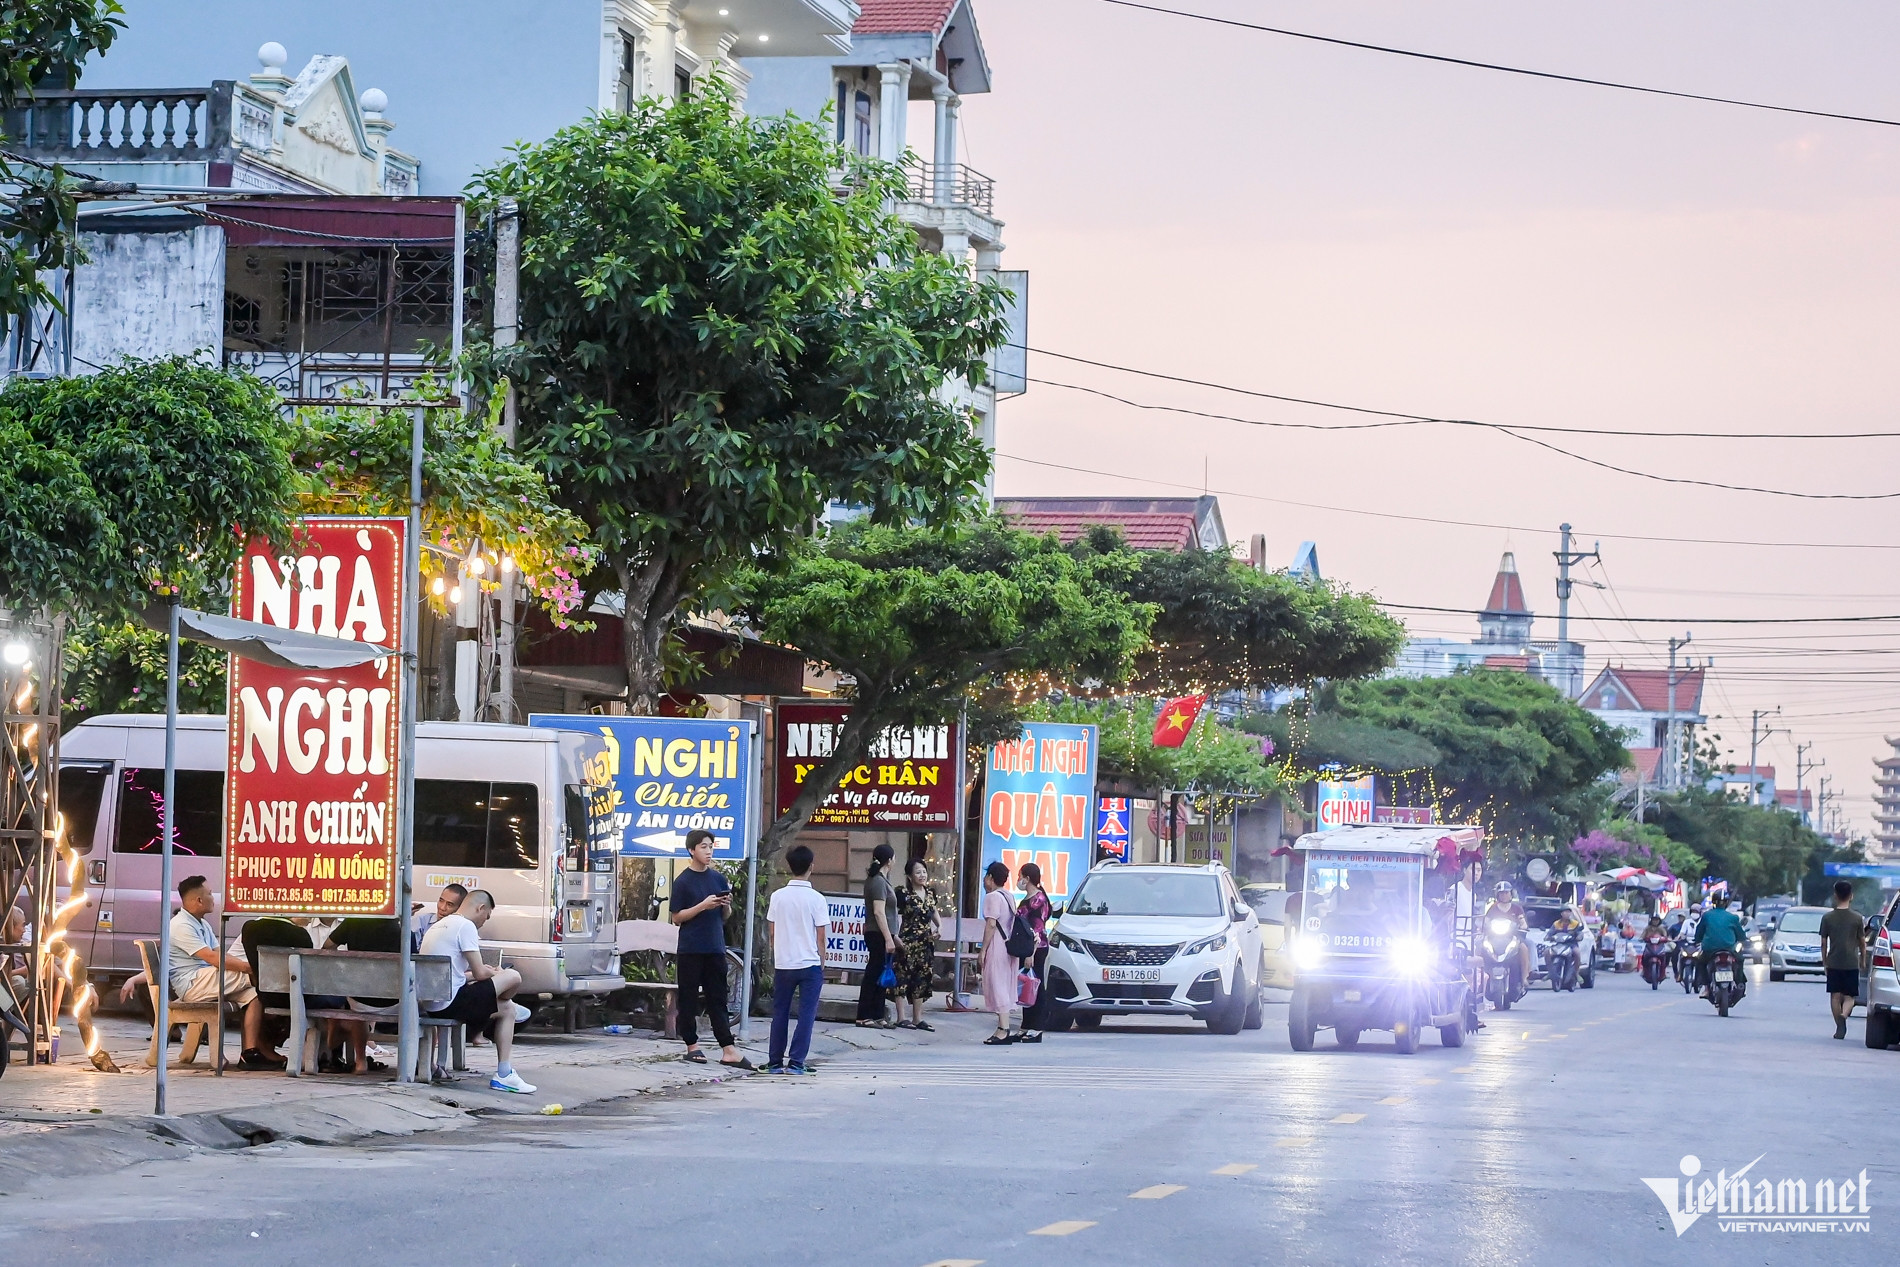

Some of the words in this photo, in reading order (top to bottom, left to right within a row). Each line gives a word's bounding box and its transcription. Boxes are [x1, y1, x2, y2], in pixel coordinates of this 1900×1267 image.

[251, 529, 387, 643] NHÀ
[239, 656, 391, 775] NGHỈ
[634, 725, 740, 779] NGHỈ
[993, 730, 1036, 776] NHÀ
[1040, 728, 1089, 779] NGHỈ
[878, 760, 939, 786] HÂN
[634, 781, 731, 809] Chiến
[843, 791, 862, 807] Vụ
[866, 789, 887, 806] Ăn
[891, 790, 930, 808] Uống
[238, 799, 298, 844] ANH
[303, 780, 386, 845] CHIẾN
[821, 808, 838, 816] Thịnh
[838, 808, 849, 817] Long
[925, 813, 935, 821] XE
[989, 782, 1087, 842] QUÂN
[1321, 790, 1371, 825] CHỈNH
[636, 810, 670, 828] ĂN
[674, 811, 735, 830] UỐNG
[814, 815, 825, 823] 367
[830, 815, 846, 823] 0987
[847, 816, 857, 824] 611
[858, 816, 869, 824] 416
[236, 856, 281, 883] PHỤC
[285, 857, 307, 883] VỤ
[311, 852, 335, 880] ĂN
[339, 850, 385, 880] UỐNG
[252, 888, 314, 902] 0916.73.85.85
[321, 889, 384, 903] 0917.56.85.85
[828, 904, 851, 917] THAY
[831, 919, 844, 934] VÁ
[827, 937, 844, 949] XE
[845, 954, 857, 962] 136
